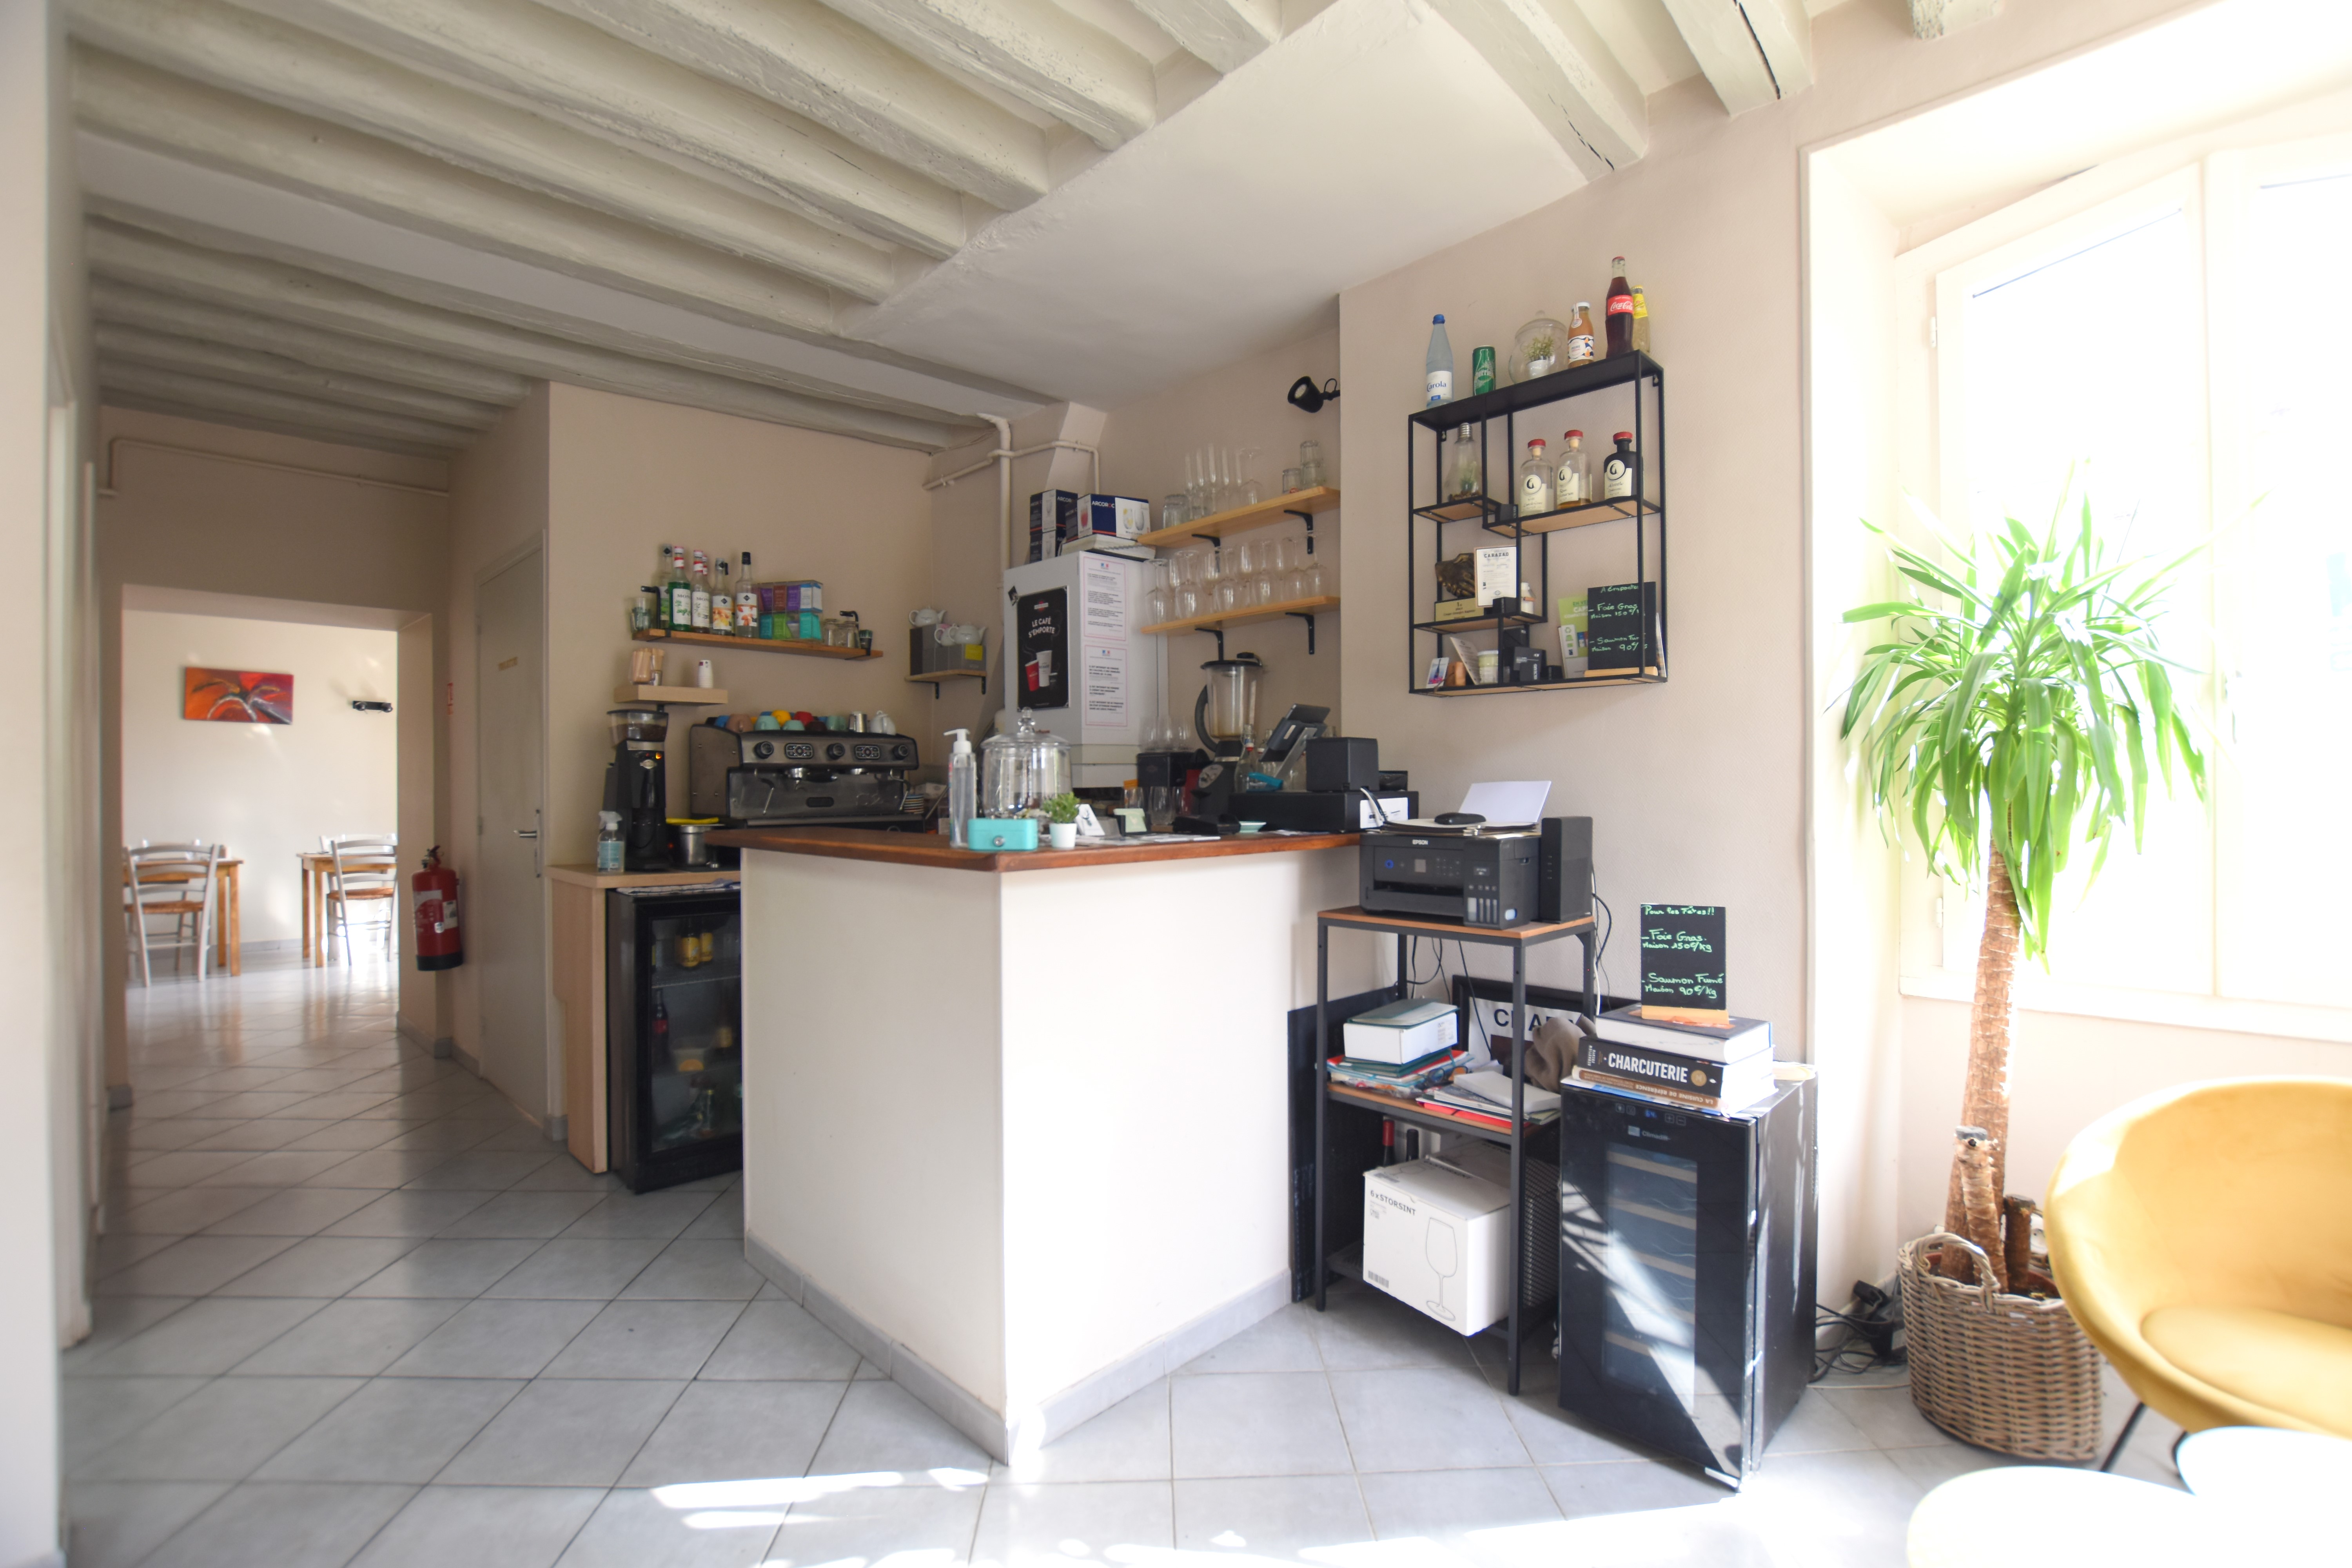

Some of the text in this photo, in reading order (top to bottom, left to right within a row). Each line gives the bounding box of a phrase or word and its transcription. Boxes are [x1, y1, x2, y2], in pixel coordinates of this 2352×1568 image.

[1427, 381, 1446, 392] Carola
[1032, 616, 1051, 628] LE CAFÉ
[1641, 905, 1664, 915] Pour
[1694, 973, 1724, 984] Fumé
[1644, 984, 1674, 994] Maison
[1608, 1053, 1688, 1083] CHARCUTERIE
[1635, 1084, 1668, 1095] RÉFÉRENCE
[1679, 1093, 1704, 1102] CUISINE
[1380, 1194, 1416, 1216] STORSINT
